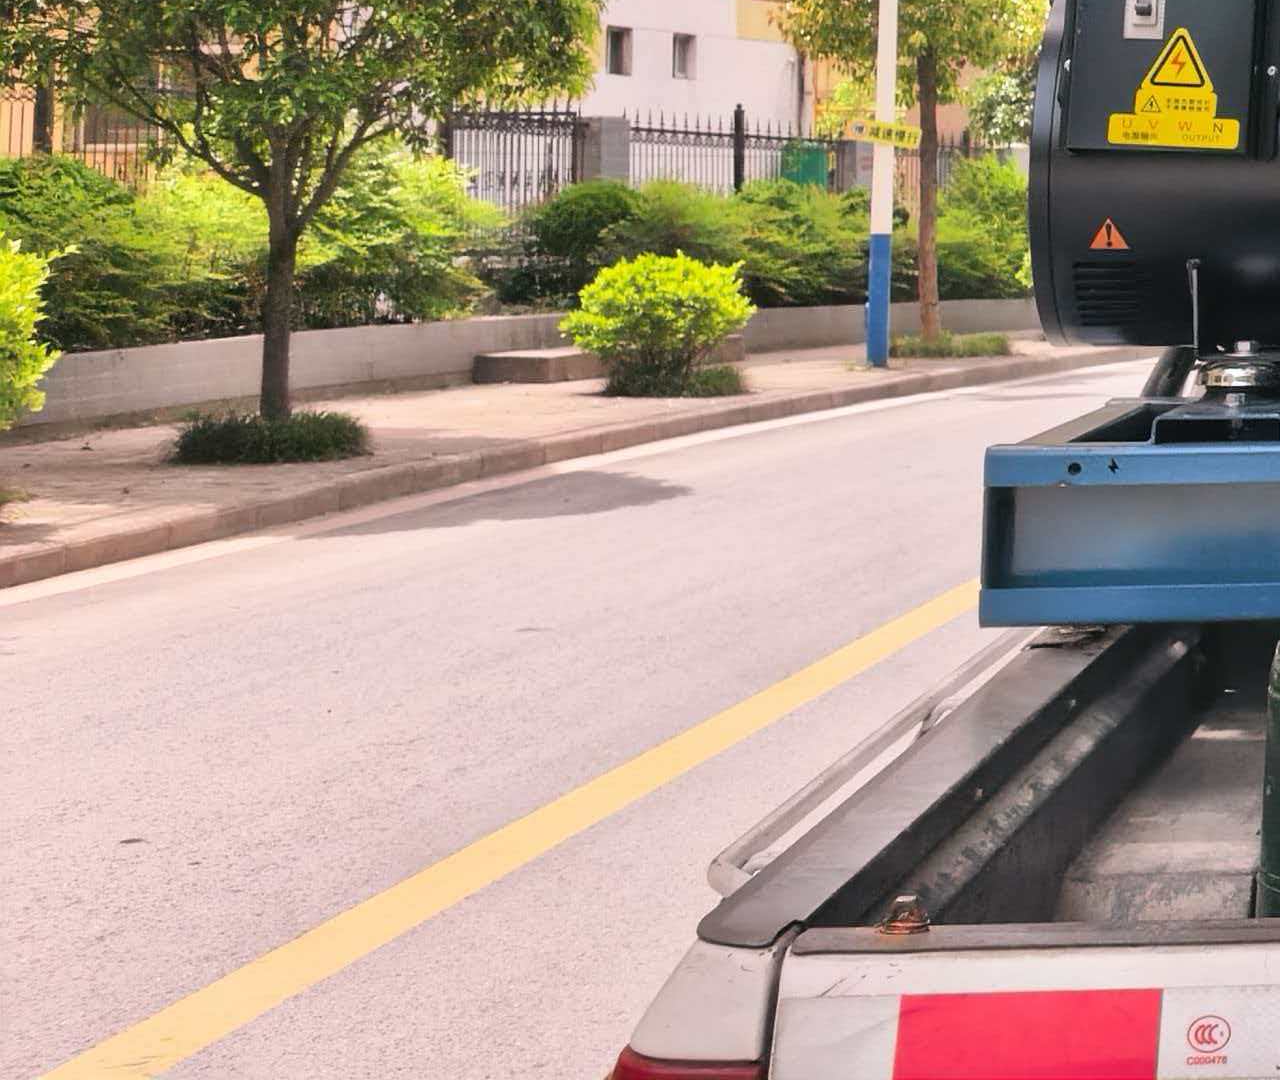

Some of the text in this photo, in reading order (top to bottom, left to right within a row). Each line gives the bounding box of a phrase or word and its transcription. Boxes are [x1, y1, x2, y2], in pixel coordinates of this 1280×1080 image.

[1178, 120, 1192, 131] W
[1212, 122, 1223, 133] N
[1182, 134, 1220, 143] OUTPUT
